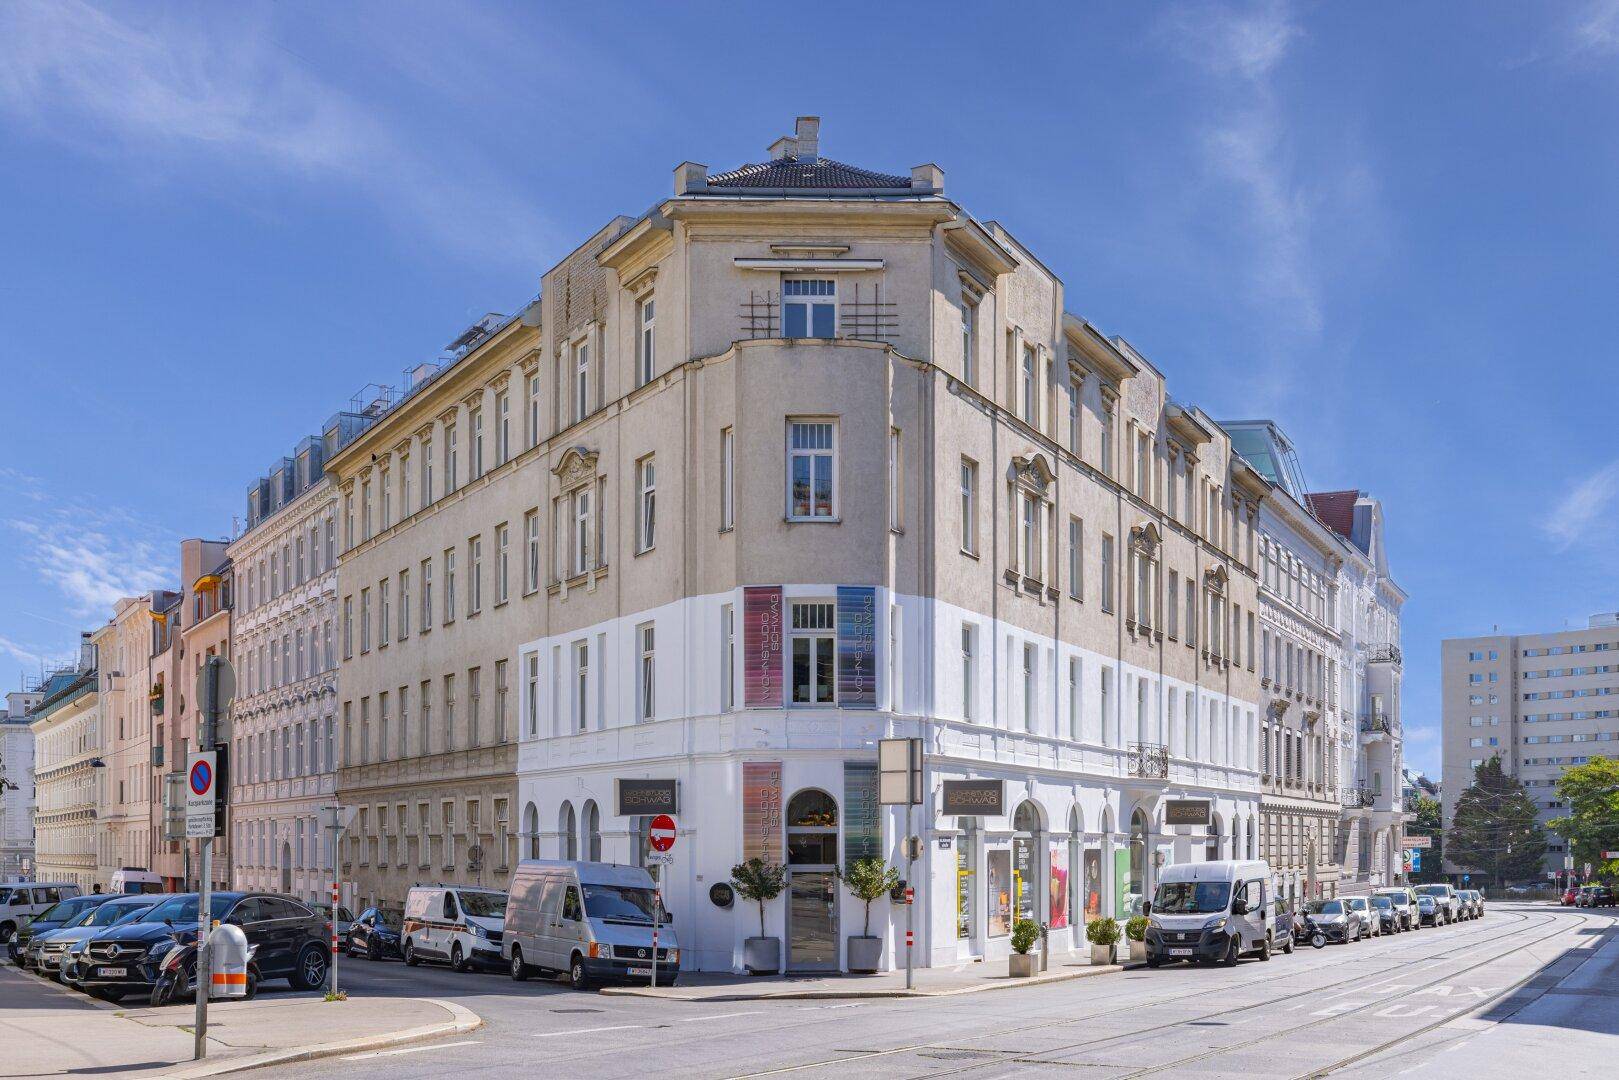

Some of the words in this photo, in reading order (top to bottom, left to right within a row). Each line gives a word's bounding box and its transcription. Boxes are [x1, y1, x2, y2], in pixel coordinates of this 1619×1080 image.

[771, 594, 779, 651] SCHWAB
[863, 595, 872, 654] SCHWAB
[761, 613, 770, 700] WOHNSTUDIO
[854, 613, 863, 701] WOHNSTUDIO
[770, 769, 779, 828] SCHWAB
[862, 788, 871, 856] HNSTUDIO
[1413, 852, 1420, 861] P
